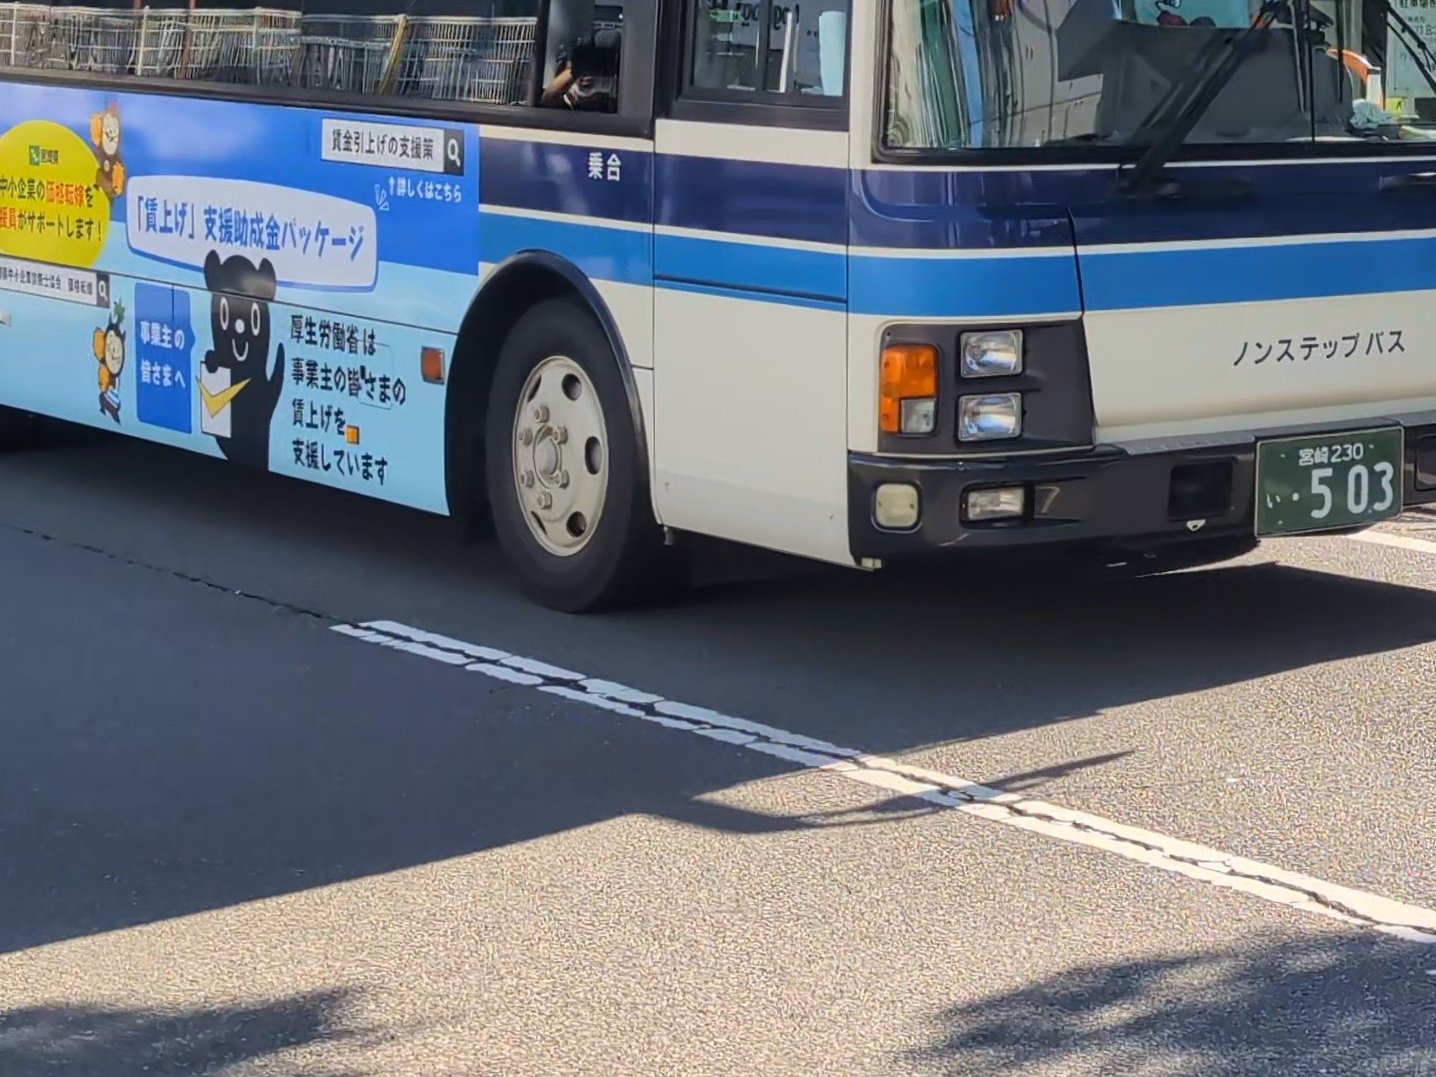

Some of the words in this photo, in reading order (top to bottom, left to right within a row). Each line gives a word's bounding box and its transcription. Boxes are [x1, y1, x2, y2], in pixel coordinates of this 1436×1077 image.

[332, 128, 434, 161] 賃金引上げの支援策
[588, 152, 621, 181] 乗合
[140, 320, 185, 350] 事業主の
[290, 315, 376, 356] 厚生労働省は
[1233, 330, 1405, 366] ノンステップバス
[141, 358, 186, 388] 皆さまへ
[291, 357, 406, 406] 事業主の皆さまの
[292, 398, 346, 436] 賃上げを
[292, 438, 388, 486] 支援しています
